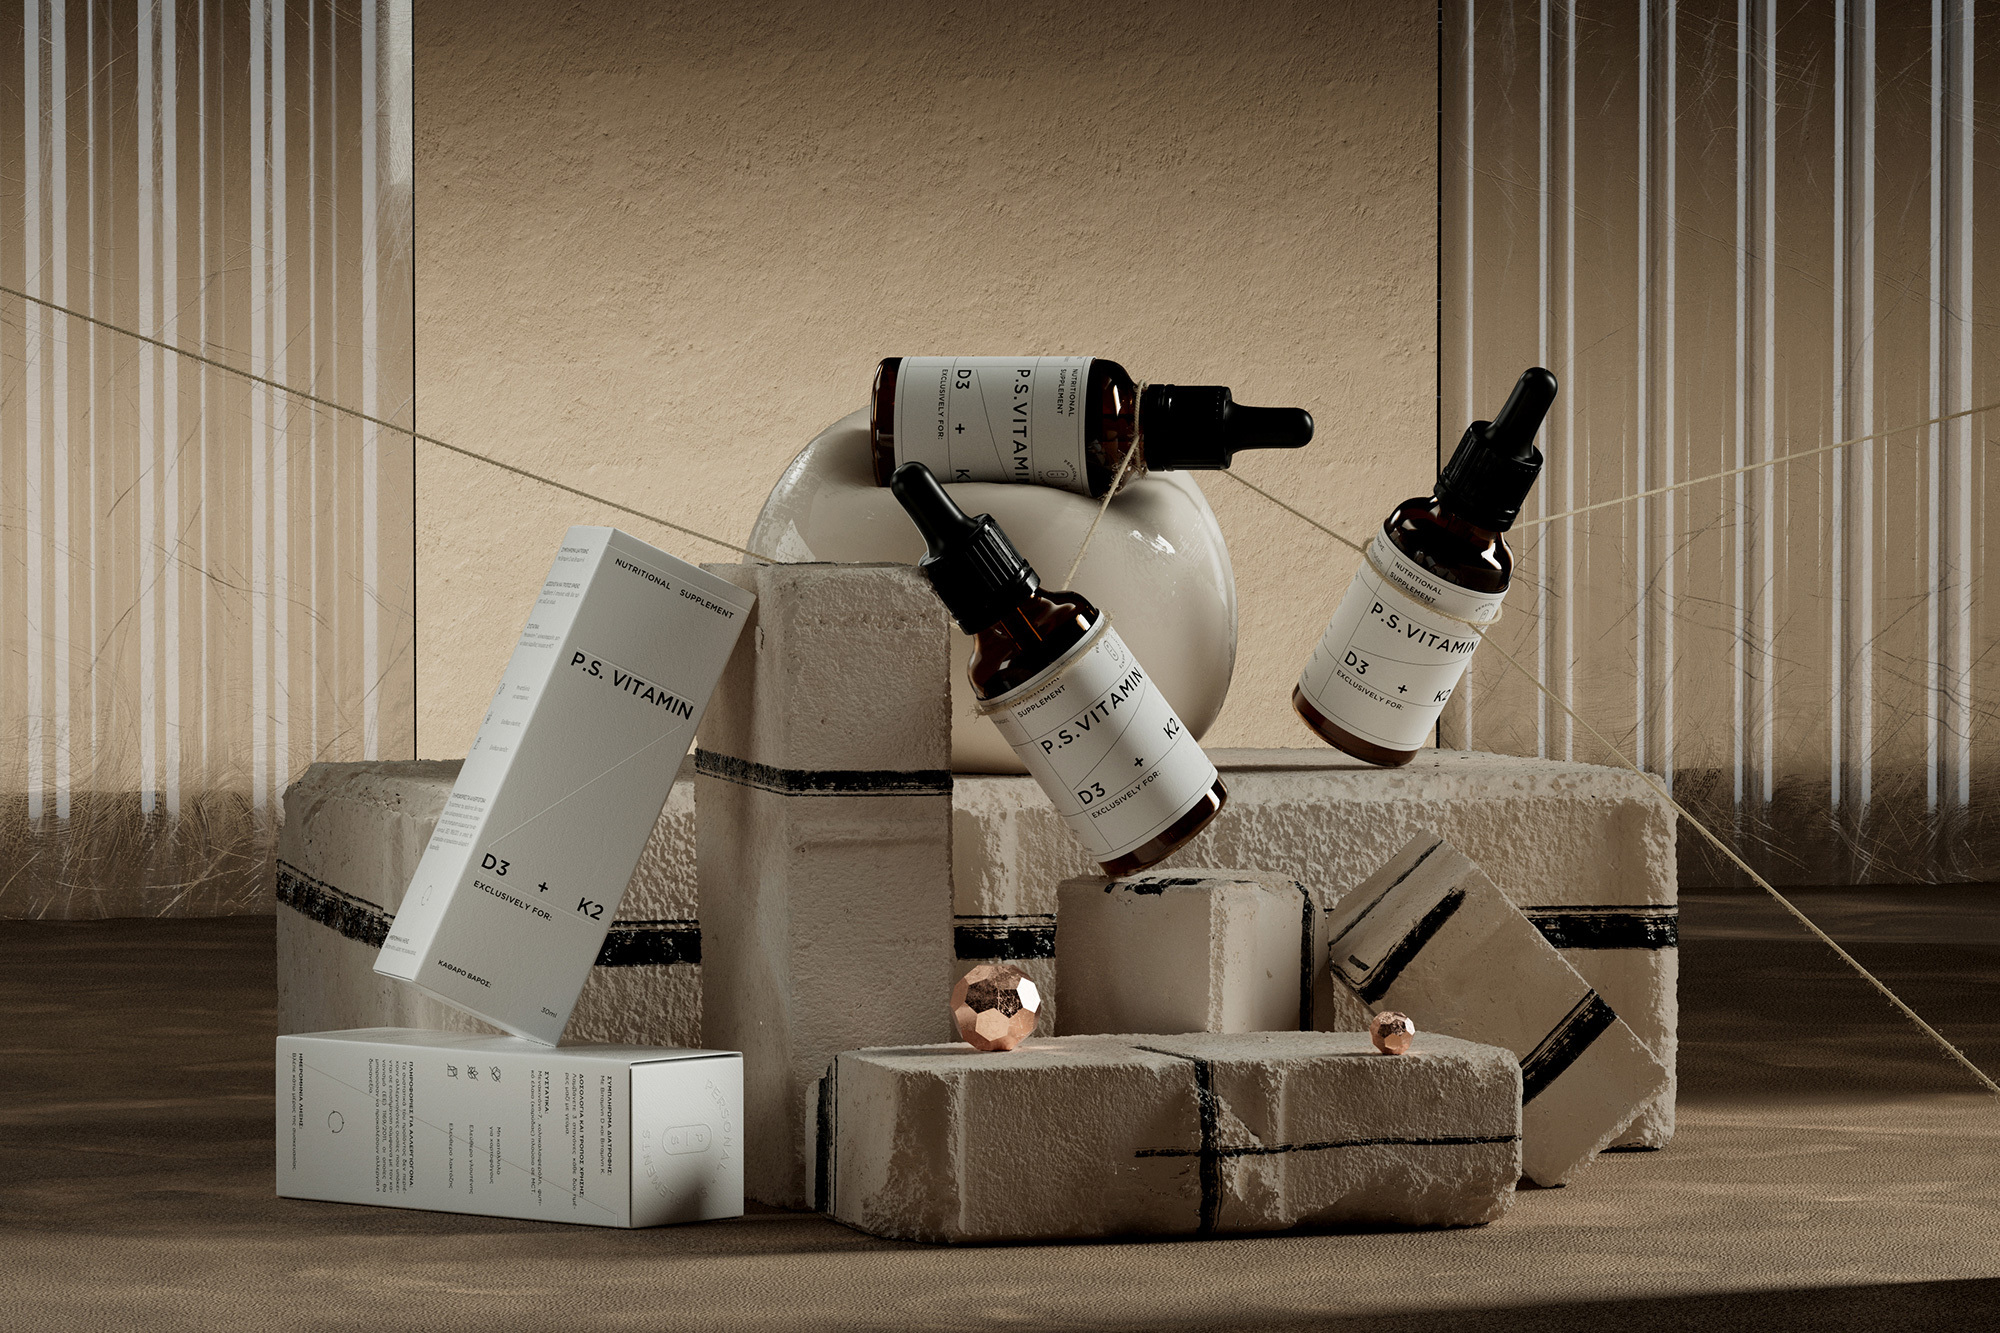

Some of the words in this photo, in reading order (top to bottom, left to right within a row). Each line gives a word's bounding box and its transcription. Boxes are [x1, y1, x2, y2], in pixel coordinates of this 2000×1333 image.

[937, 368, 949, 418] EXCLUSIVELY
[955, 369, 972, 390] D3
[1057, 368, 1067, 415] SUPPLEMENT
[1068, 368, 1078, 417] NUTRITIONAL
[955, 423, 965, 434] +
[955, 469, 971, 482] K
[615, 558, 672, 590] NUTRITIONAL
[679, 589, 735, 620] SUPPLEMENT
[1389, 571, 1436, 604] SUPPLEMENT
[1394, 561, 1442, 596] NUTRITIONAL
[1370, 602, 1478, 654] P.S.VITAMIN
[570, 651, 604, 681] P.S.
[612, 670, 695, 721] VITAMIN
[1336, 669, 1385, 703] EXCLUSIVELY
[1386, 698, 1404, 711] FOR:
[1344, 651, 1370, 675] D3
[1398, 684, 1408, 694] +
[1017, 684, 1066, 718] SUPPLEMENT
[1040, 666, 1144, 755] P.S.VITAMIN
[1077, 782, 1106, 805] D3
[1134, 757, 1144, 768] +
[1163, 717, 1180, 740] K2
[1091, 782, 1141, 819] EXCLUSIVELY
[1142, 770, 1162, 787] FOR:
[473, 880, 531, 911] EXCLUSIVELY
[531, 906, 553, 922] FOR:
[481, 853, 511, 877] D3
[538, 881, 549, 893] +
[576, 896, 604, 921] K2
[438, 959, 467, 977] ΚΑΘΑΡΟ
[541, 1006, 558, 1019] 30ml
[704, 1079, 732, 1171] PERSONAL
